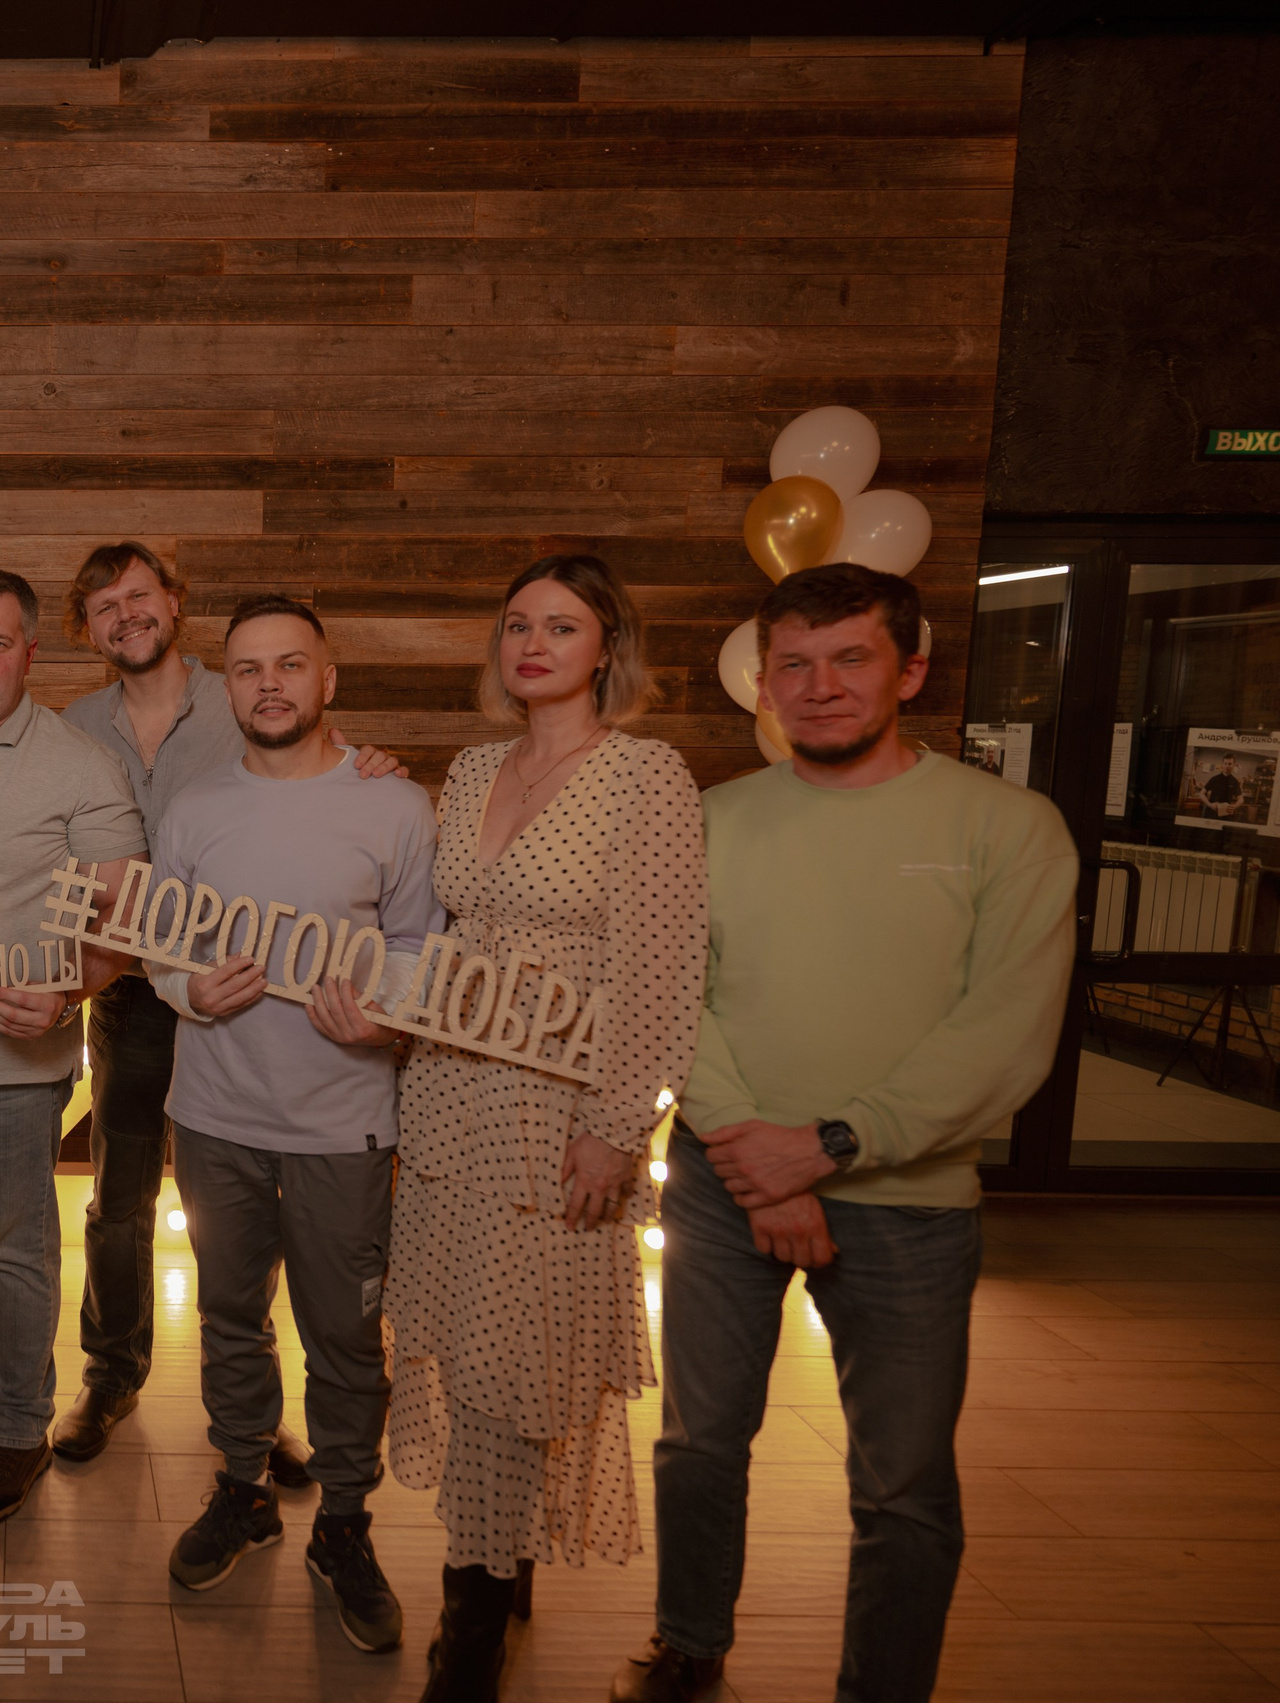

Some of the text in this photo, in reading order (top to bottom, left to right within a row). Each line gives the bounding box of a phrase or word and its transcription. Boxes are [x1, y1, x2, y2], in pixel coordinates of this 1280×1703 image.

[1197, 732, 1234, 743] Андрей
[37, 935, 82, 986] ТЫ
[40, 856, 605, 1076] #ДОРОГОЮ ДОБРА
